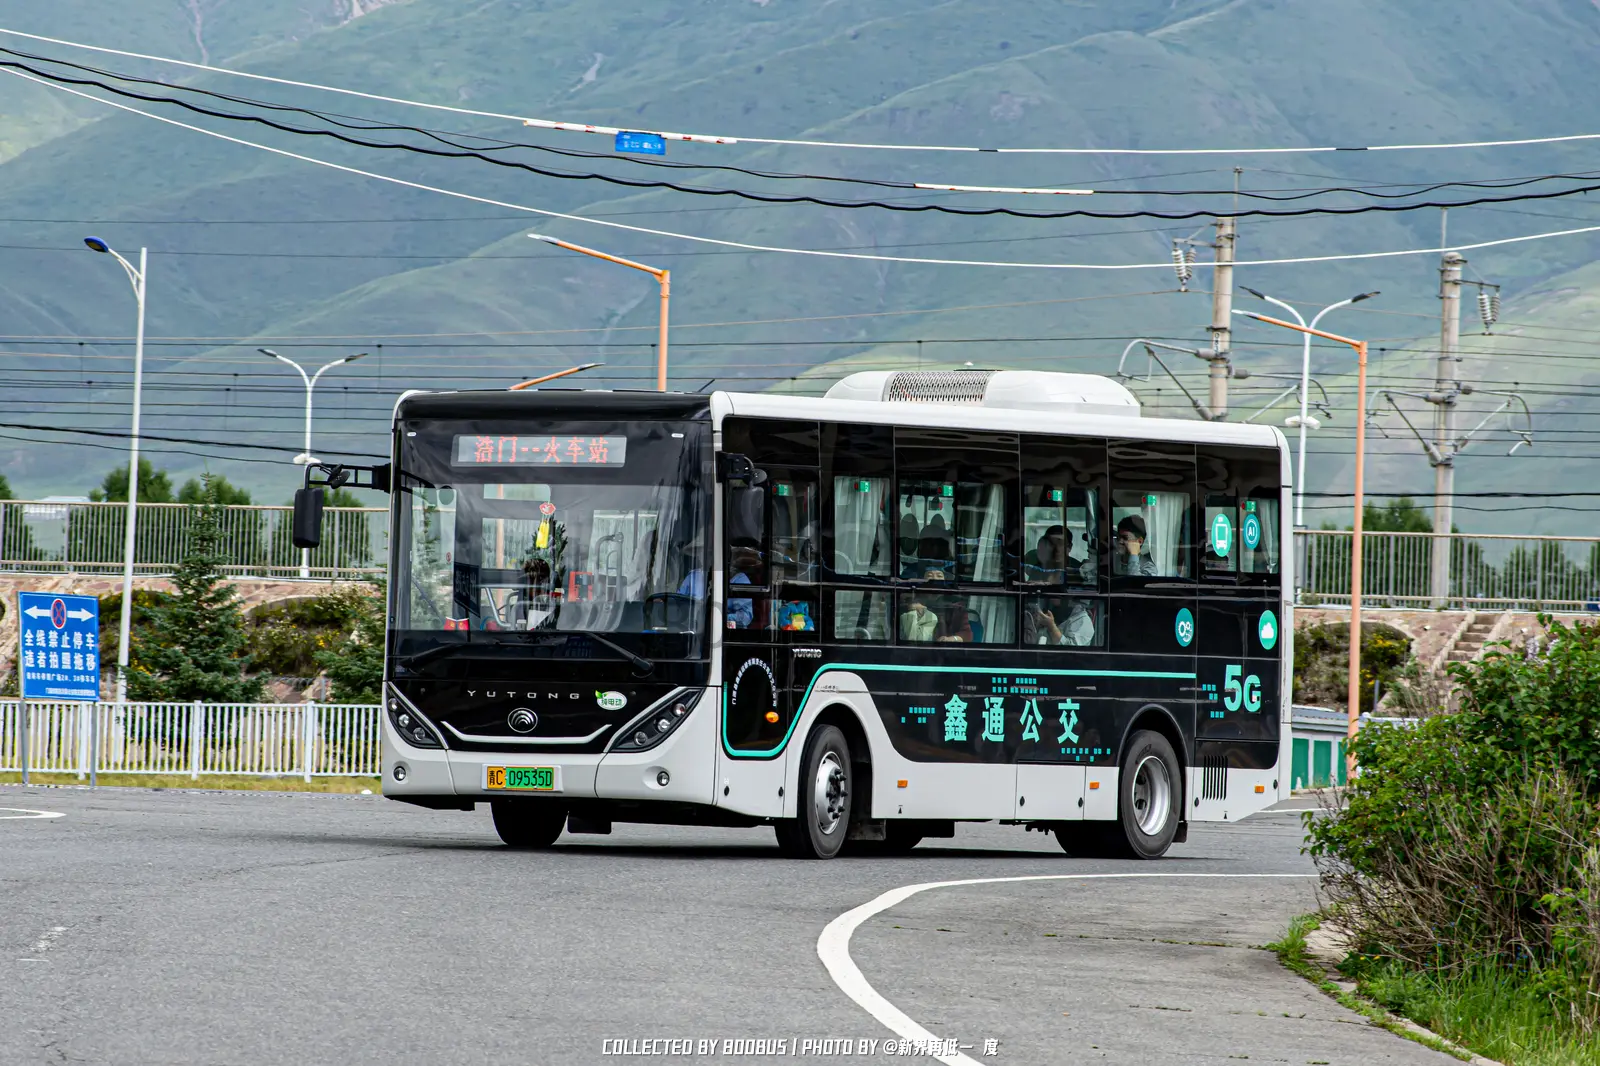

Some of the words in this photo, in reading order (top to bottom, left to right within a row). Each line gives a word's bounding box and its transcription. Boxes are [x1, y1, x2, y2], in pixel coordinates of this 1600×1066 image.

[1248, 526, 1255, 537] AI
[24, 629, 95, 650] 全线禁止停车
[467, 690, 580, 700] YUTONG
[1224, 664, 1261, 712] 5G
[944, 694, 1080, 744] 鑫通公交
